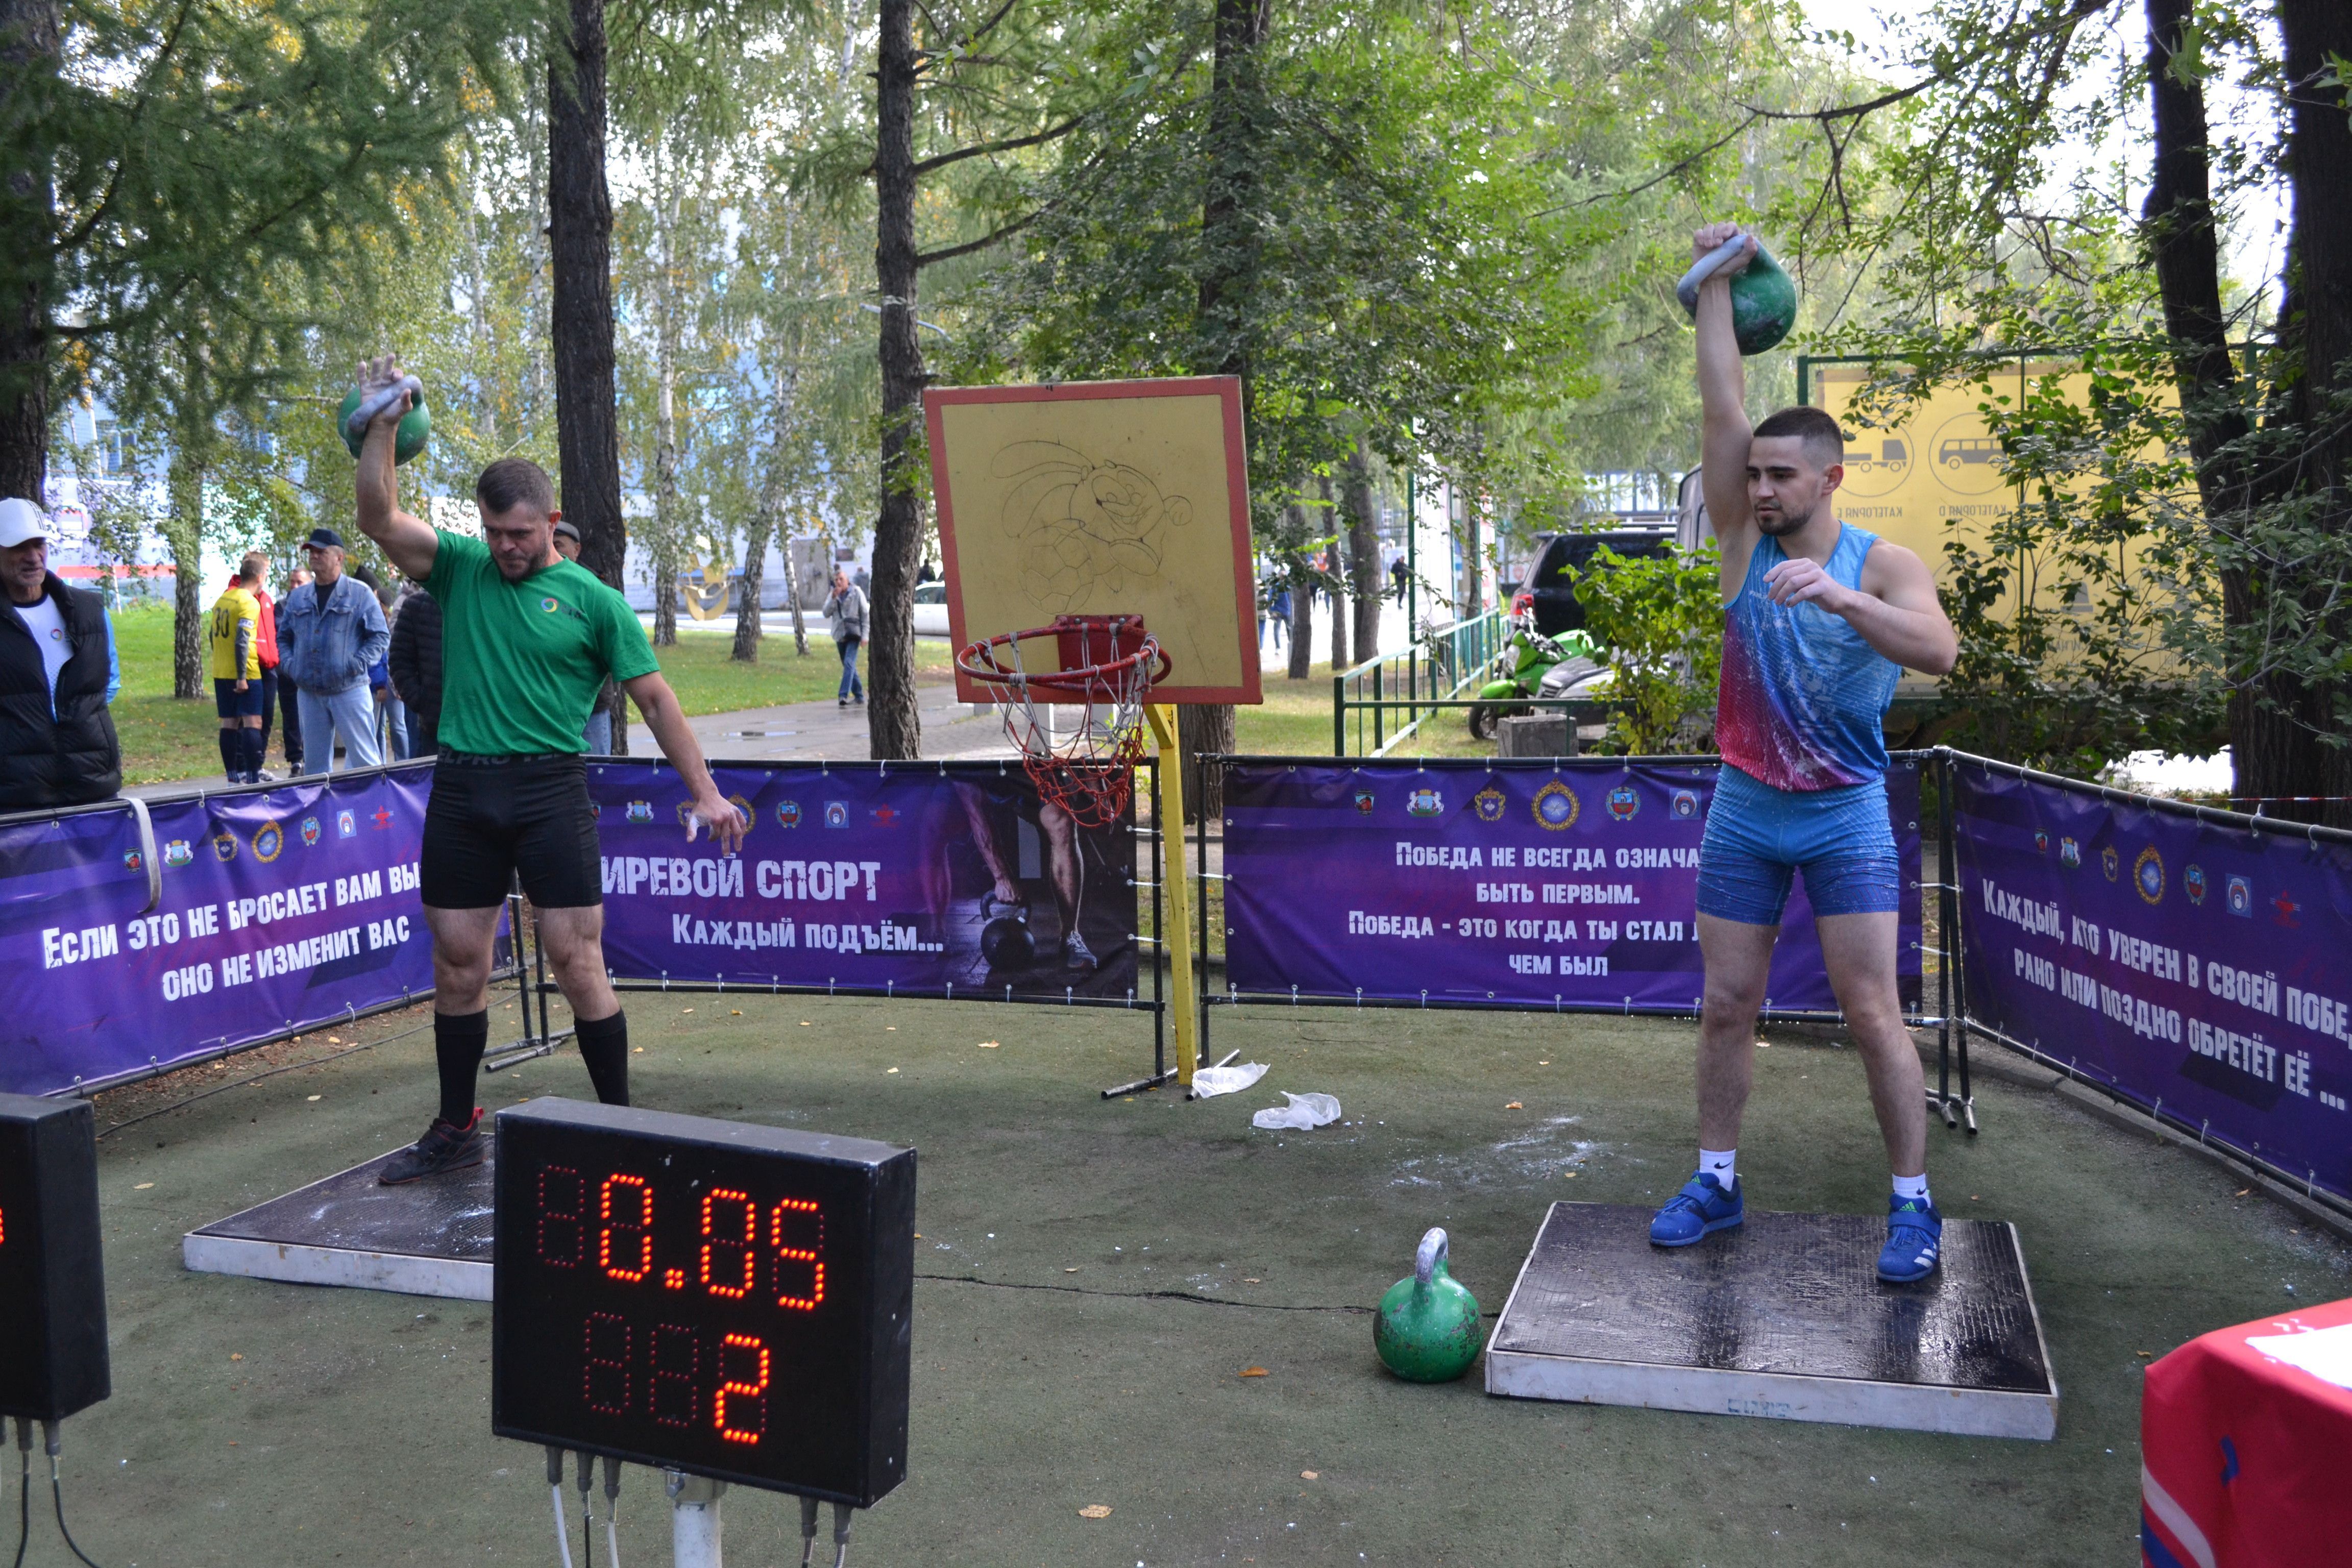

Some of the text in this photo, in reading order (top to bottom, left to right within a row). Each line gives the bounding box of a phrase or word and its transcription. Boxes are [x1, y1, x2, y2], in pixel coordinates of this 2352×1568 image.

[756, 860, 881, 901] СПОРТ
[1477, 883, 1640, 904] БЫТЬ ПЕРВЫМ.
[1491, 847, 1516, 867] НЕ
[1524, 847, 1607, 871] ВСЕГДА
[128, 913, 180, 950] ЭТО
[187, 904, 219, 938] НЕ
[227, 881, 328, 929] БРОСАЕТ
[335, 870, 382, 906] ВАМ
[1459, 918, 1497, 938] ЭТО
[1505, 919, 1578, 943] КОГДА
[1586, 920, 1618, 940] ТЫ
[1626, 921, 1683, 941] СТАЛ
[162, 915, 410, 1001] ОНО НЕ ИЗМЕНИТ ВАС
[1509, 954, 1608, 976] ЧЕМ БЫЛ
[2072, 915, 2099, 955] КТО
[2108, 928, 2180, 982] УВЕРЕН
[2188, 953, 2199, 988] В
[2207, 962, 2277, 1016] СВОЕЙ
[2014, 948, 2055, 991] РАНО
[2061, 967, 2097, 1009] ИЛИ
[2100, 984, 2180, 1043] ПОЗДНО
[2188, 1017, 2276, 1082] ОБРЕТЁТ
[2285, 1050, 2310, 1097] ЕЁ
[601, 1173, 825, 1310] 0.05
[715, 1333, 770, 1444] 2
